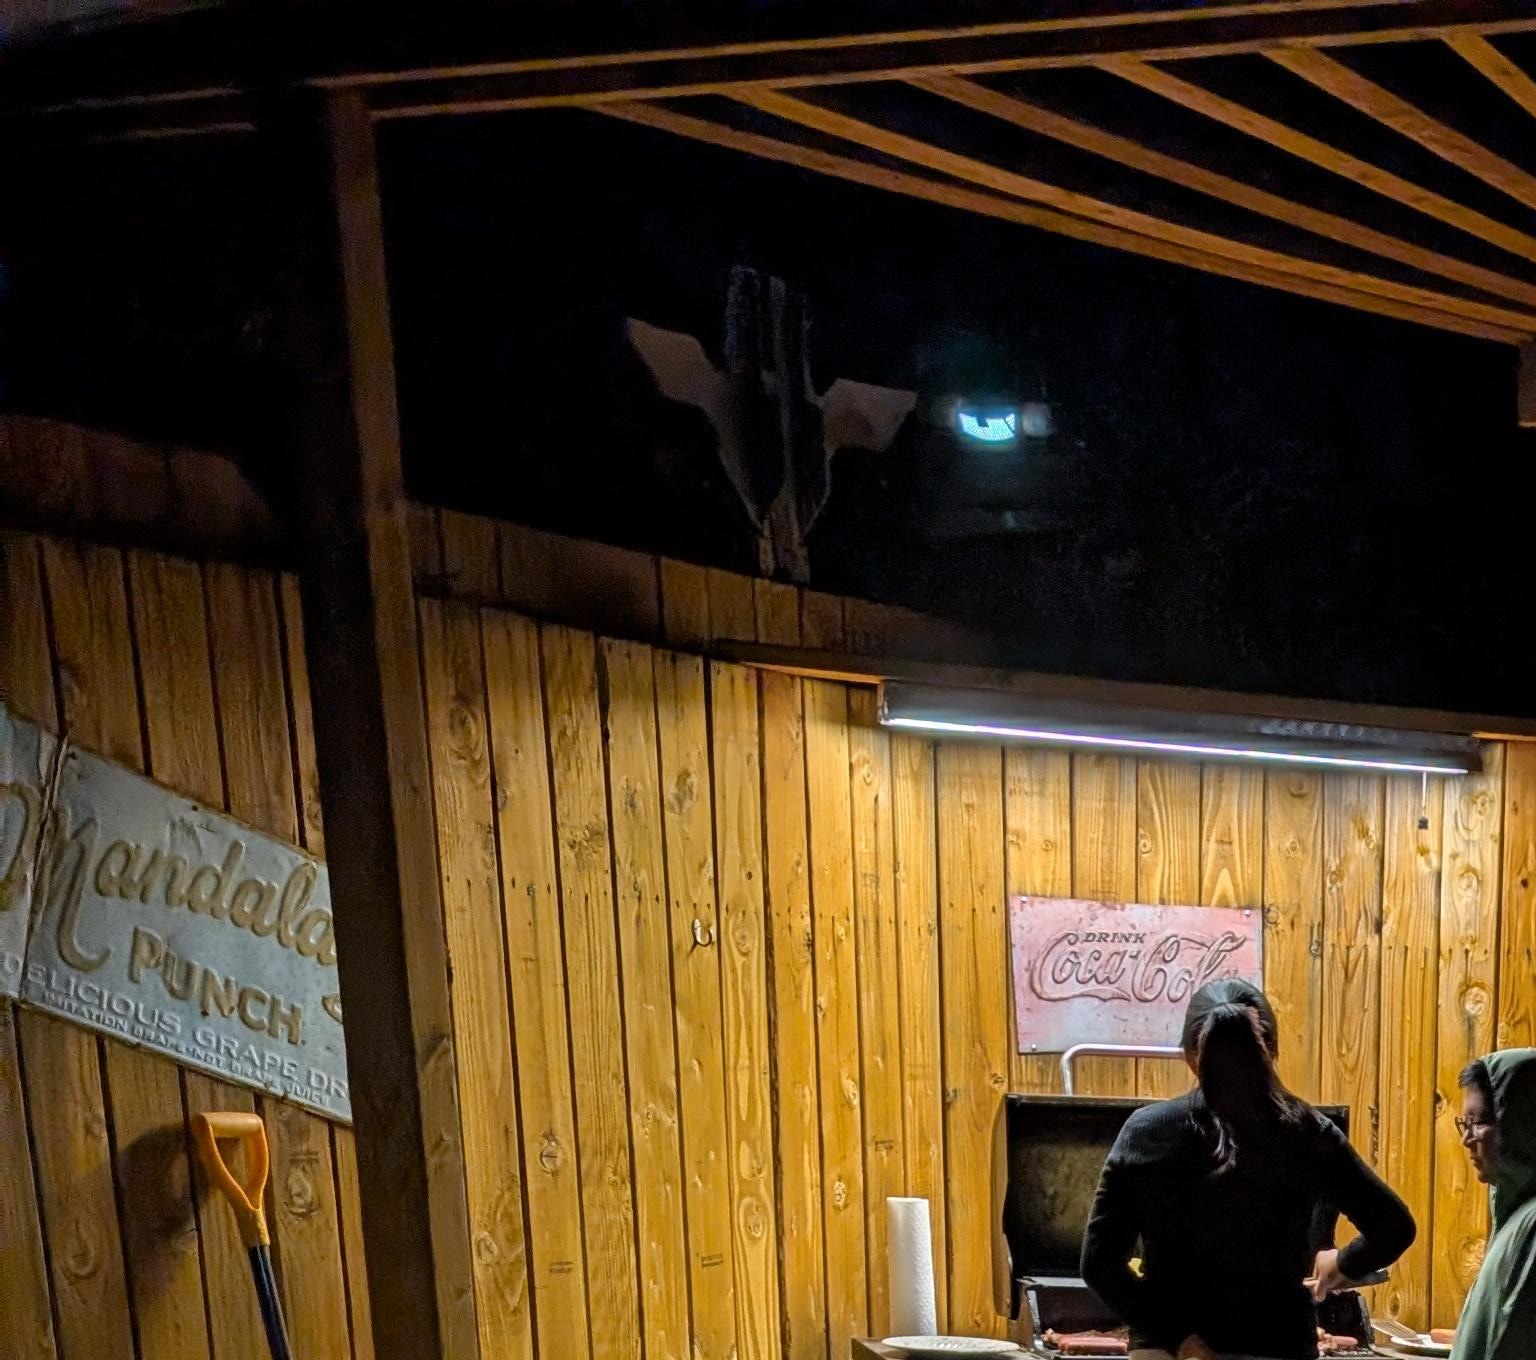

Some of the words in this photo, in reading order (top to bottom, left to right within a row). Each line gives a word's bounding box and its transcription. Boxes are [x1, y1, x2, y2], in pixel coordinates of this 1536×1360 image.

[1030, 930, 1247, 1002] Coca-Col
[1083, 931, 1147, 945] DRINK
[193, 1024, 299, 1082] GRAPE
